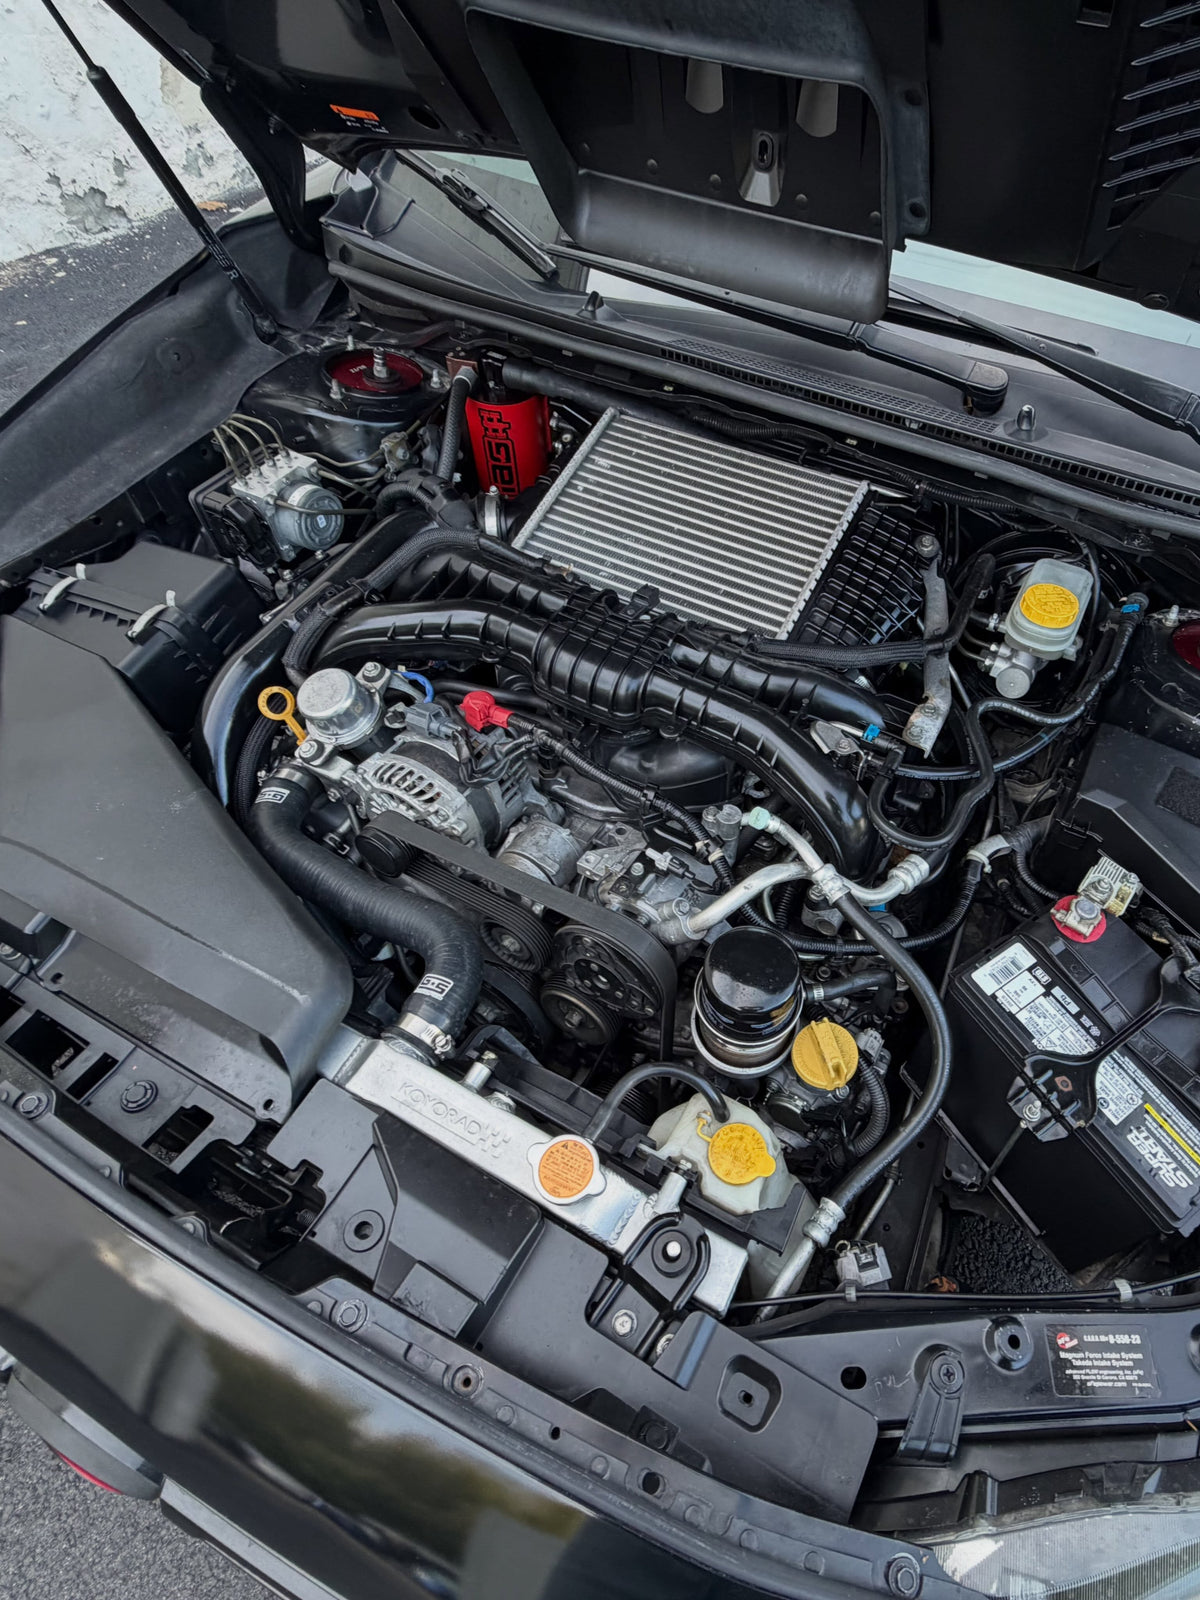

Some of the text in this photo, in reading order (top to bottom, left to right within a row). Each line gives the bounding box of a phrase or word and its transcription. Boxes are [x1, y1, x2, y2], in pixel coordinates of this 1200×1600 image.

[1058, 993, 1071, 1006] Pb
[397, 1081, 481, 1136] KOYORAD
[1126, 1133, 1176, 1187] SUPER
[1130, 1125, 1194, 1188] START
[1121, 1352, 1143, 1360] System
